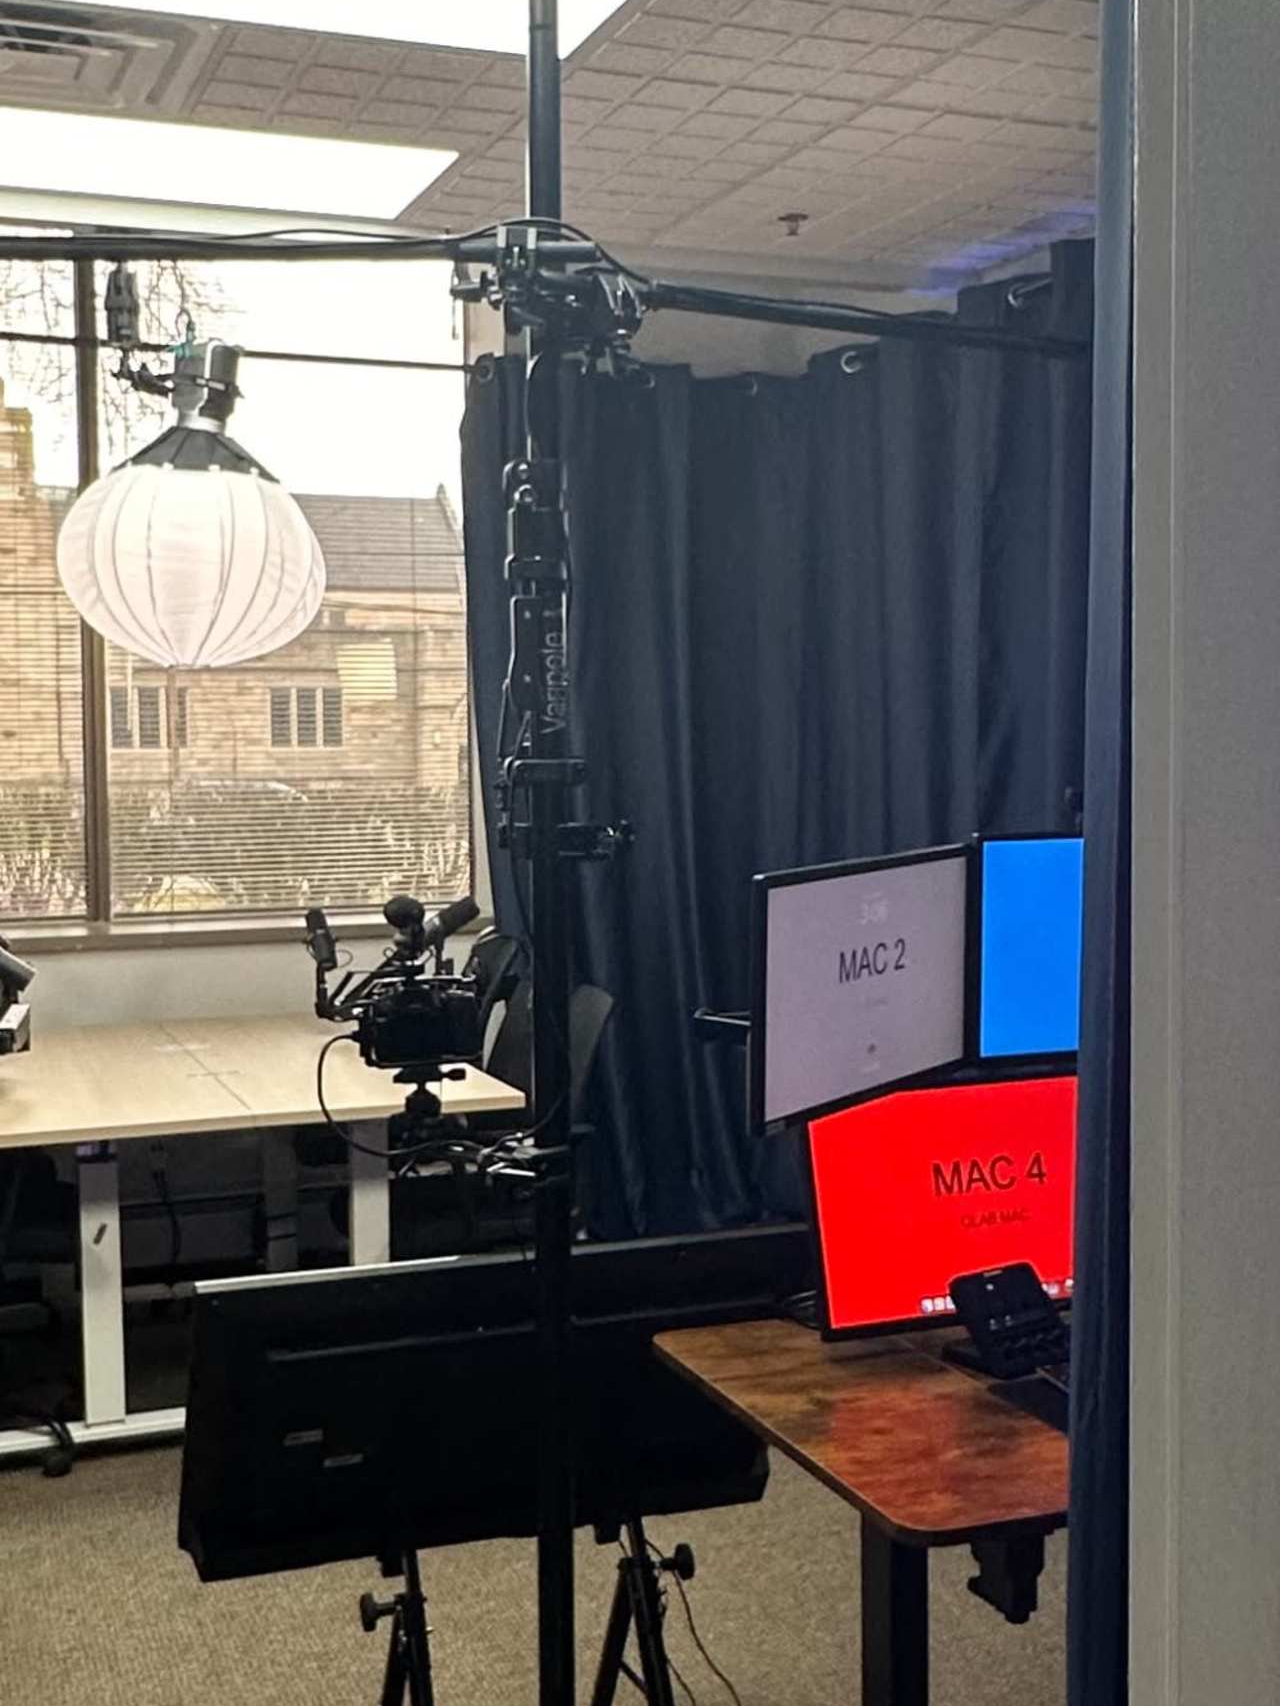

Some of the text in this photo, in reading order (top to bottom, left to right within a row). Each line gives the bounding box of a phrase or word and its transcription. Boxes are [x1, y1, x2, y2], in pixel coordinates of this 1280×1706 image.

[839, 938, 906, 983] MAC 2
[931, 1151, 1047, 1196] MAC 4
